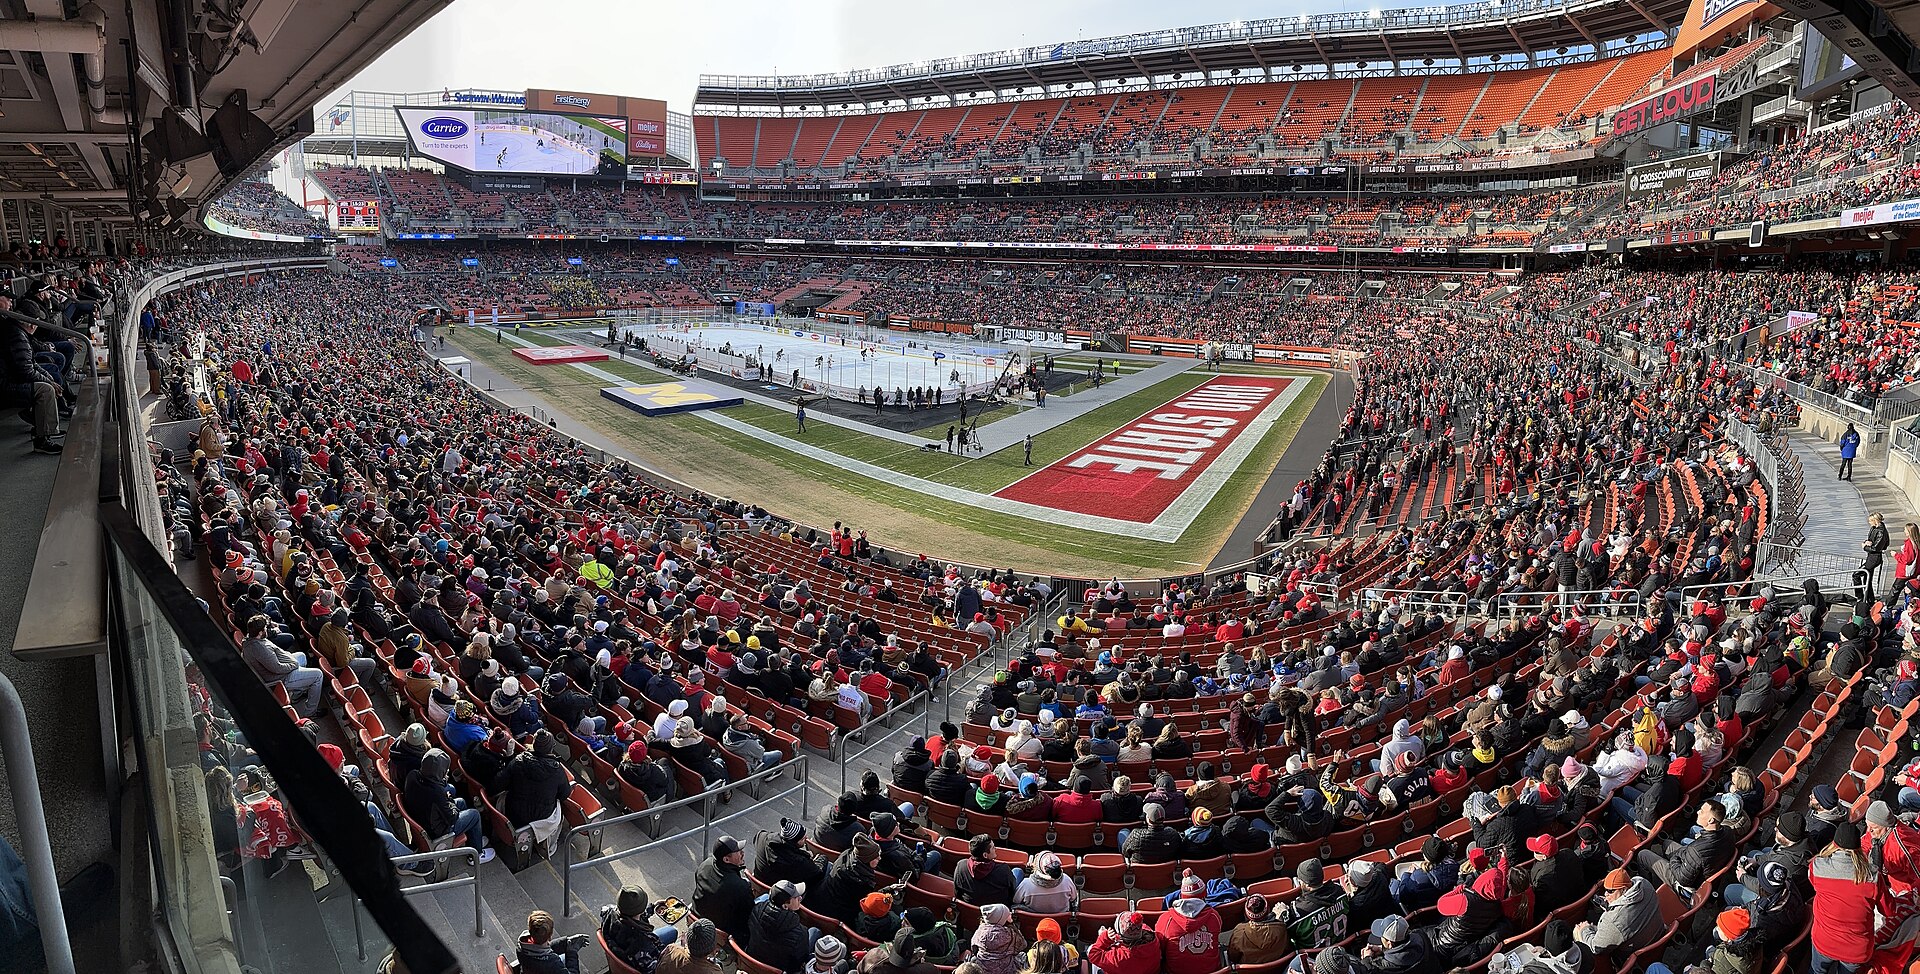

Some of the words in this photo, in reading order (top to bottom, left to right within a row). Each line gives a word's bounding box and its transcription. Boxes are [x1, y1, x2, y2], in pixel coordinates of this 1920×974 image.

[555, 94, 591, 108] FirstEnergy
[1613, 101, 1650, 135] GET
[1652, 75, 1715, 121] LOUD
[1850, 110, 1864, 121] TEXT
[1863, 105, 1882, 118] ISSUES
[1882, 101, 1892, 112] TO
[427, 122, 463, 134] Carrier
[637, 122, 659, 134] meijer
[1455, 163, 1463, 171] 82
[1639, 167, 1687, 183] CROSSCOUNTRY
[1688, 168, 1712, 178] LANDING
[1639, 180, 1664, 191] MORTGAGE
[1852, 208, 1876, 224] meijer
[911, 320, 944, 332] CLEVELAND
[946, 322, 972, 334] BROWNS
[1003, 327, 1045, 341] ESTABLISHED
[1047, 331, 1064, 343] 1946
[1174, 384, 1275, 412] OHIO
[1067, 412, 1239, 481] STATE
[1404, 777, 1428, 798] SOLON
